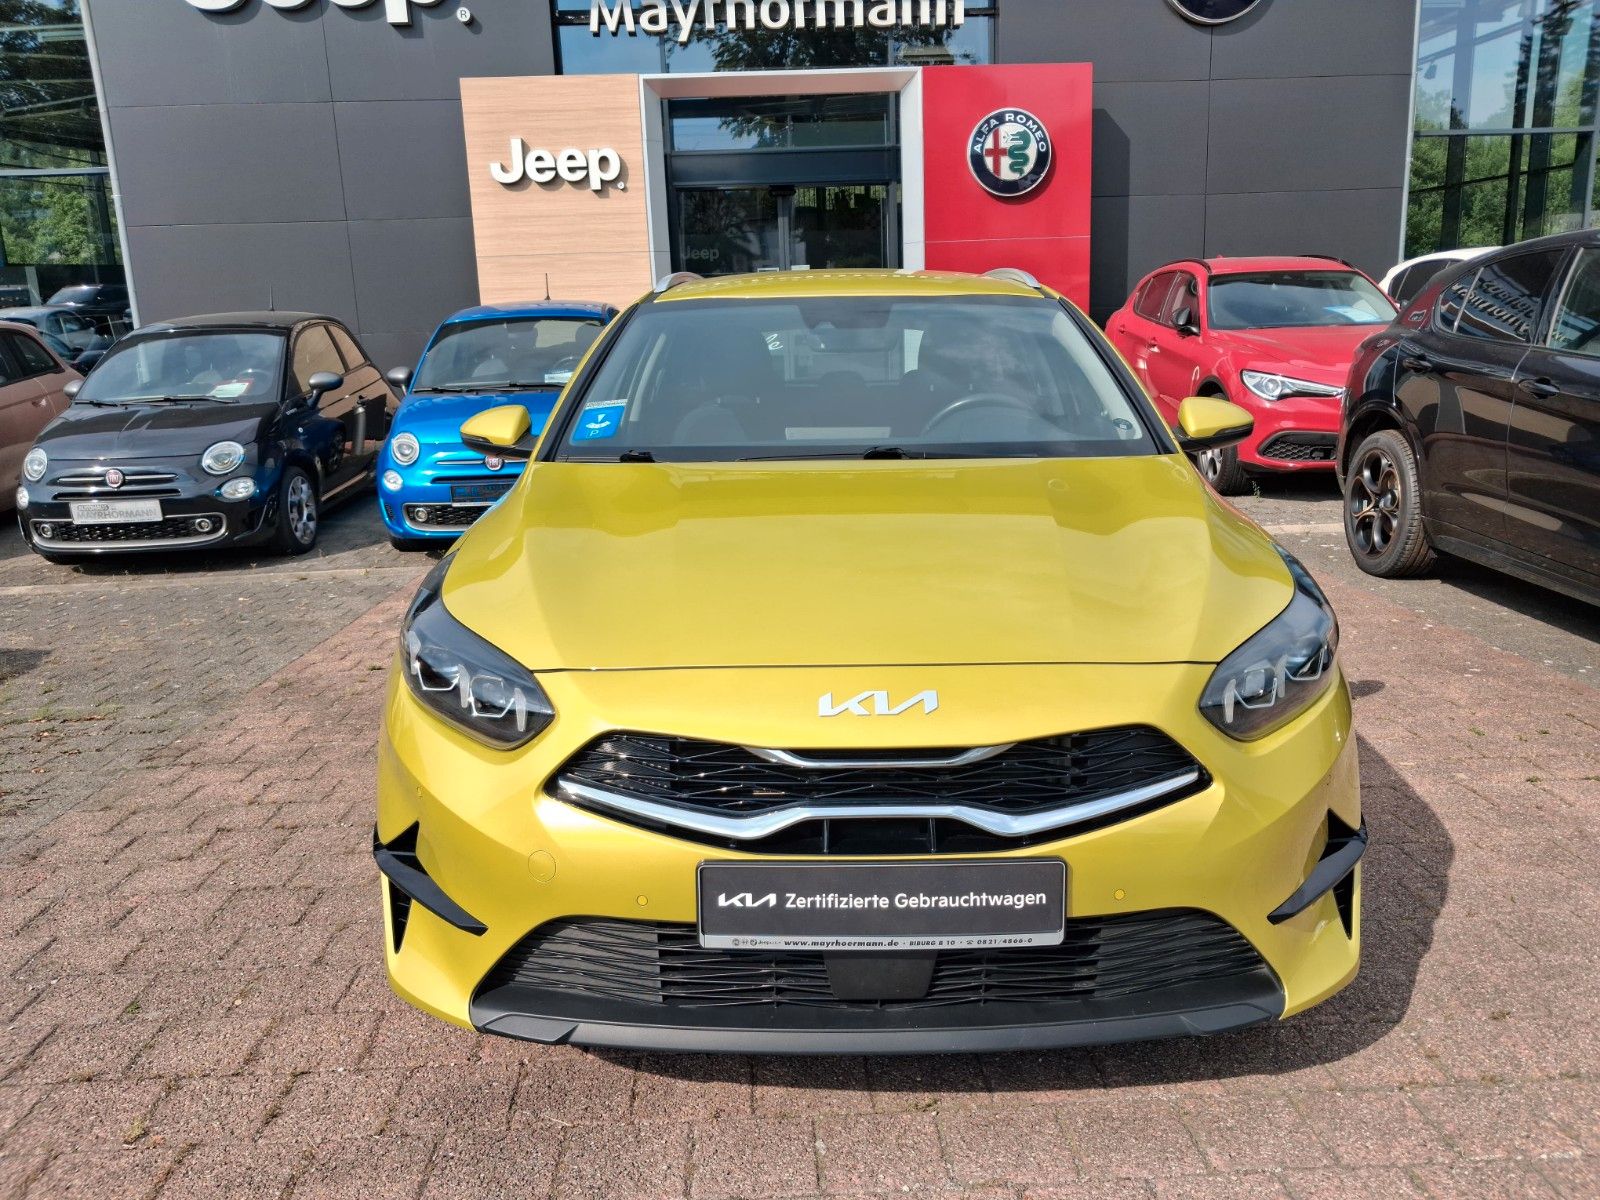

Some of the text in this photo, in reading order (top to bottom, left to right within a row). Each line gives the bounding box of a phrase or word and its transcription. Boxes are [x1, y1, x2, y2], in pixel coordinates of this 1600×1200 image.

[973, 113, 1047, 153] ALFA ROMEO
[818, 690, 939, 717] KIA
[717, 890, 1047, 909] KIA Zertifizierte Gebrauchtwagen
[784, 938, 899, 948] www.mayrhoermann.de
[909, 939, 936, 947] BIBURG
